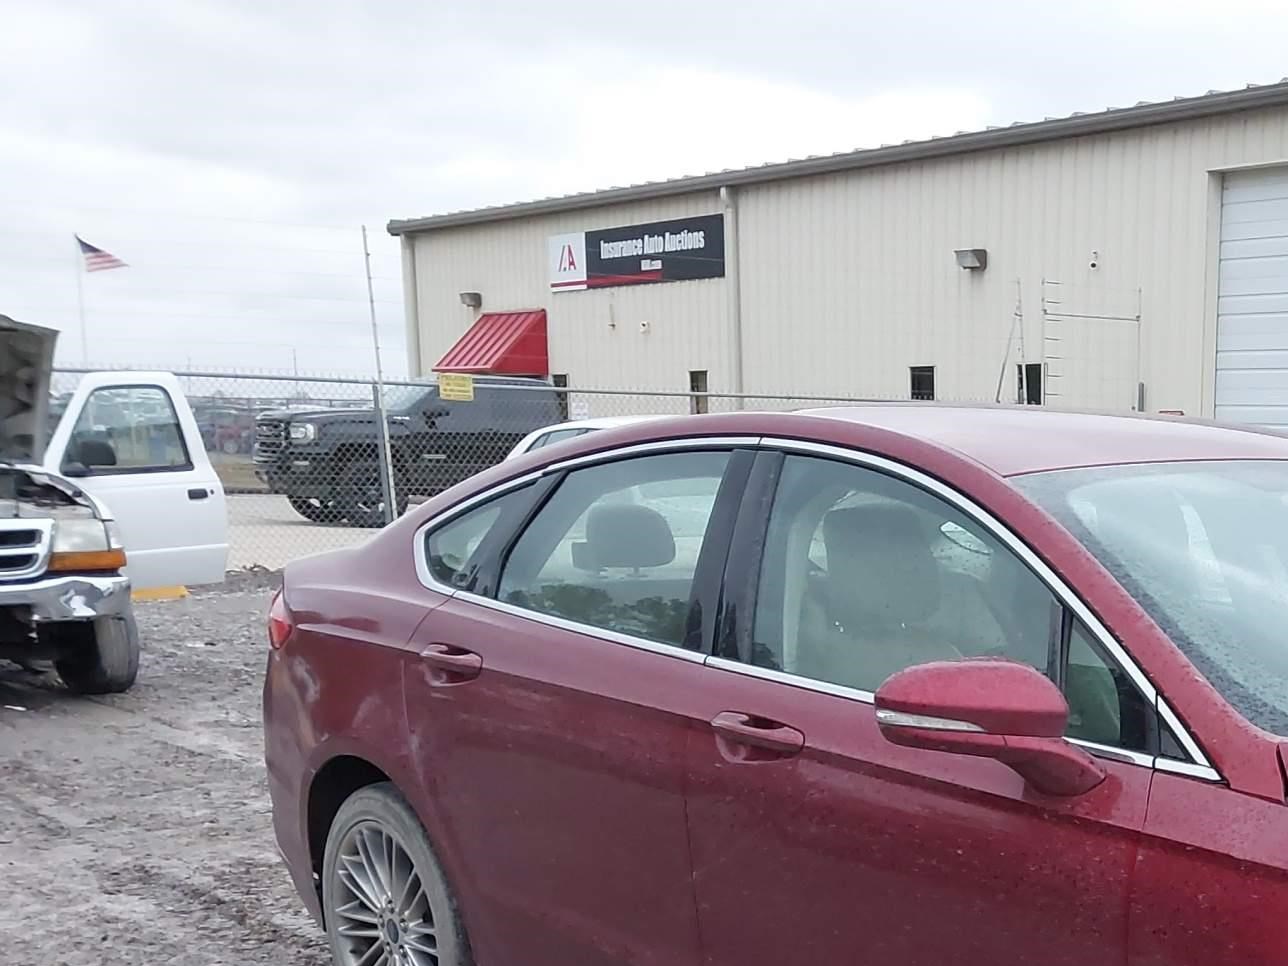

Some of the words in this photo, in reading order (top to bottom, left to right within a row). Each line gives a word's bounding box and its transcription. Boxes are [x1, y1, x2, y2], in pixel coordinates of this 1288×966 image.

[600, 238, 643, 260] Insurance
[644, 234, 663, 255] Auto
[664, 229, 705, 252] Auctions
